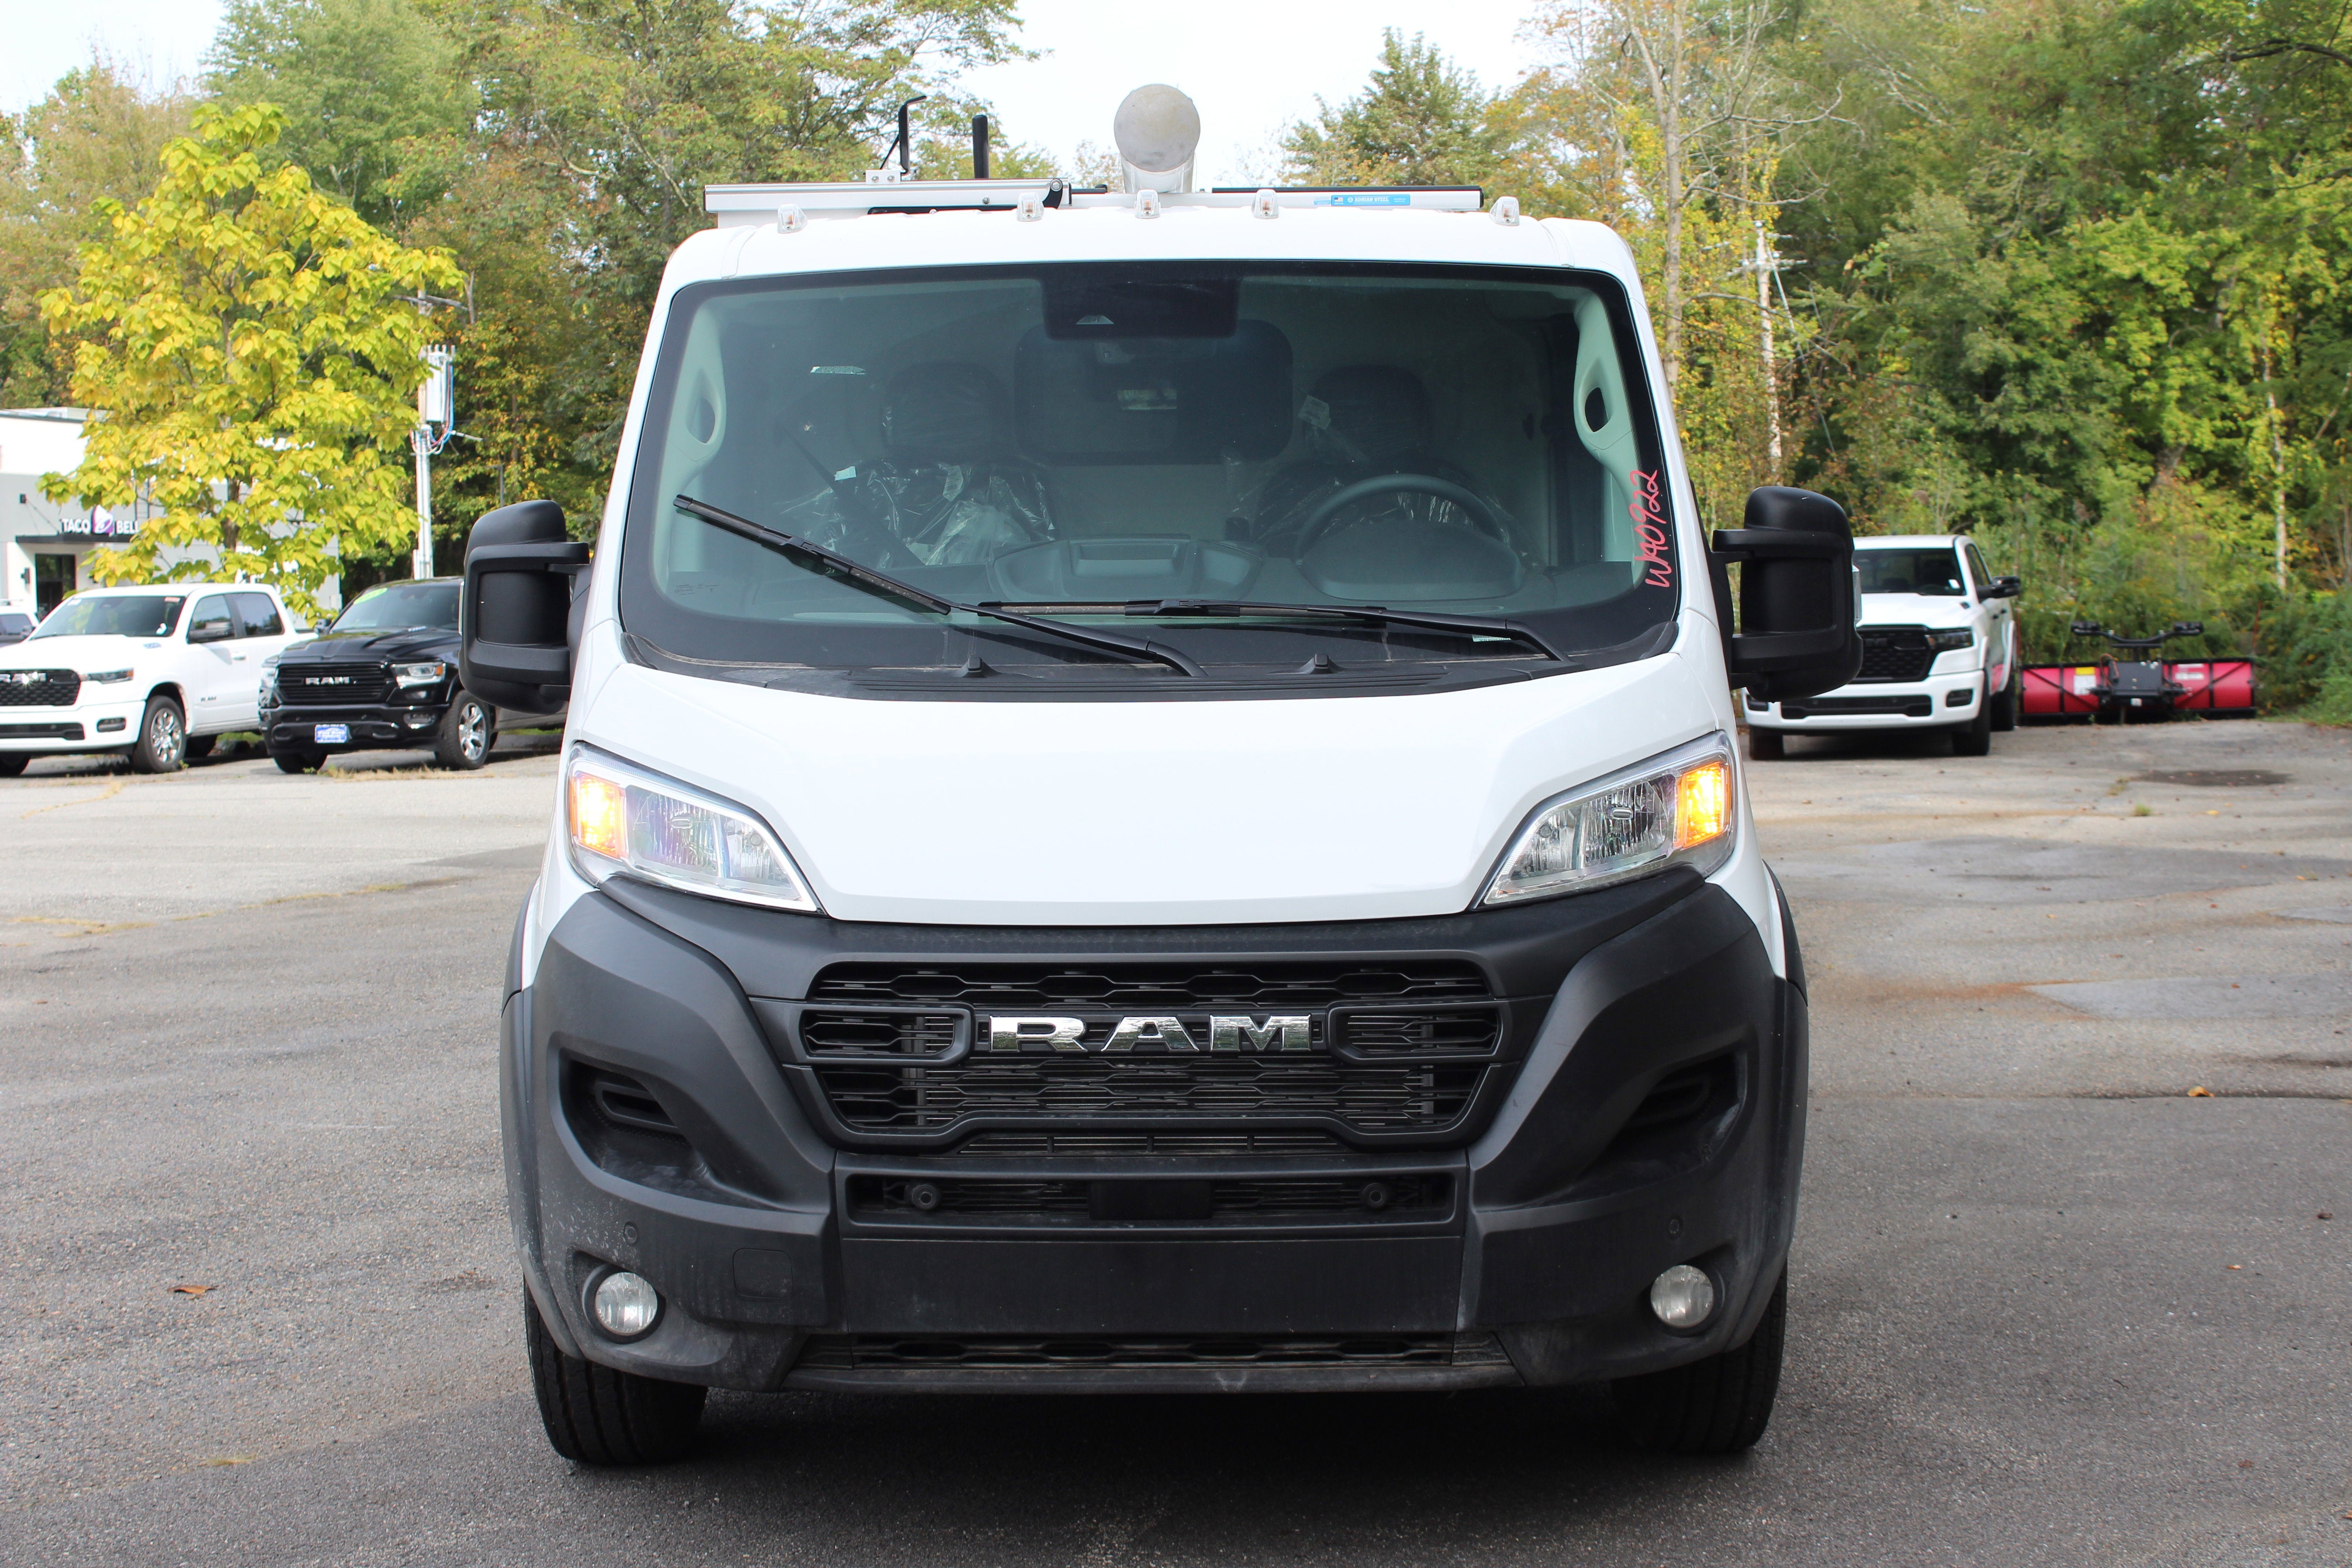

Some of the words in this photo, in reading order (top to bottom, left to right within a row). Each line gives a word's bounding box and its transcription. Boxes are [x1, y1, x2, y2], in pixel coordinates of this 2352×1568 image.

[61, 519, 90, 534] TACO
[305, 676, 350, 686] RAM
[990, 1014, 1312, 1052] RAM
